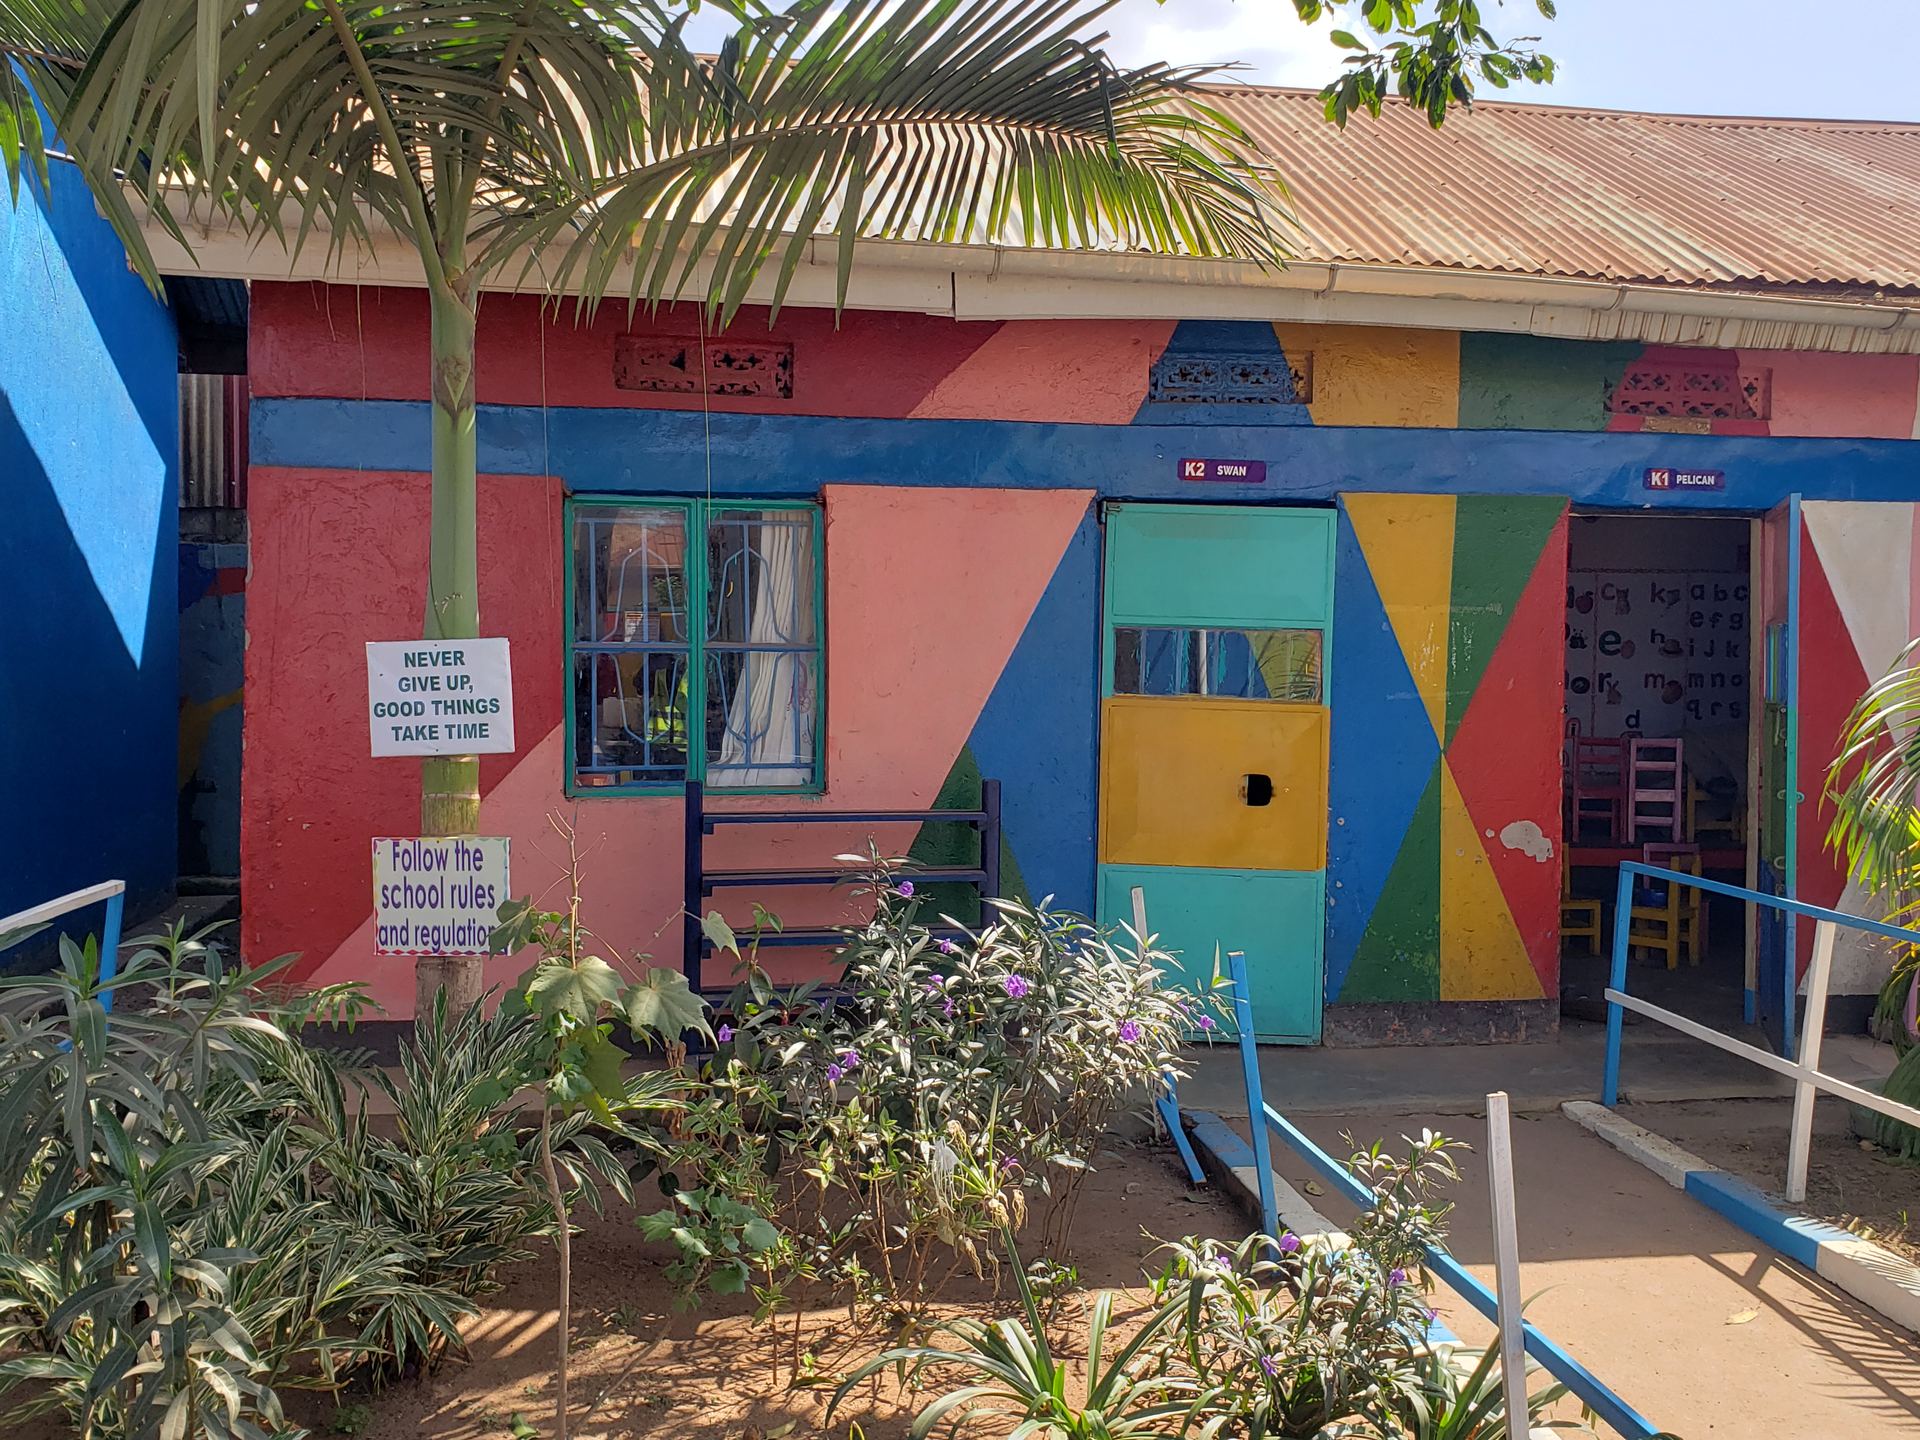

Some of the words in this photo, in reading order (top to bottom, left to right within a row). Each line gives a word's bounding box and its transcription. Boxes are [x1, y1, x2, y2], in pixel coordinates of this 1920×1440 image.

[1185, 462, 1205, 476] K2
[1217, 465, 1247, 477] SWAN
[1651, 471, 1669, 486] K1
[1676, 474, 1715, 485] PELICAN
[1600, 630, 1622, 656] e
[404, 650, 465, 668] NEVER
[398, 675, 441, 692] GIVE
[446, 674, 474, 694] UP,
[374, 701, 425, 718] GOOD
[431, 698, 500, 715] THINGS
[1625, 709, 1640, 729] d
[391, 725, 439, 742] TAKE
[445, 722, 490, 739] TIME
[392, 841, 449, 872] Follow
[454, 840, 484, 871] the
[381, 876, 444, 909] school
[450, 876, 495, 909] rules
[378, 918, 409, 947] and
